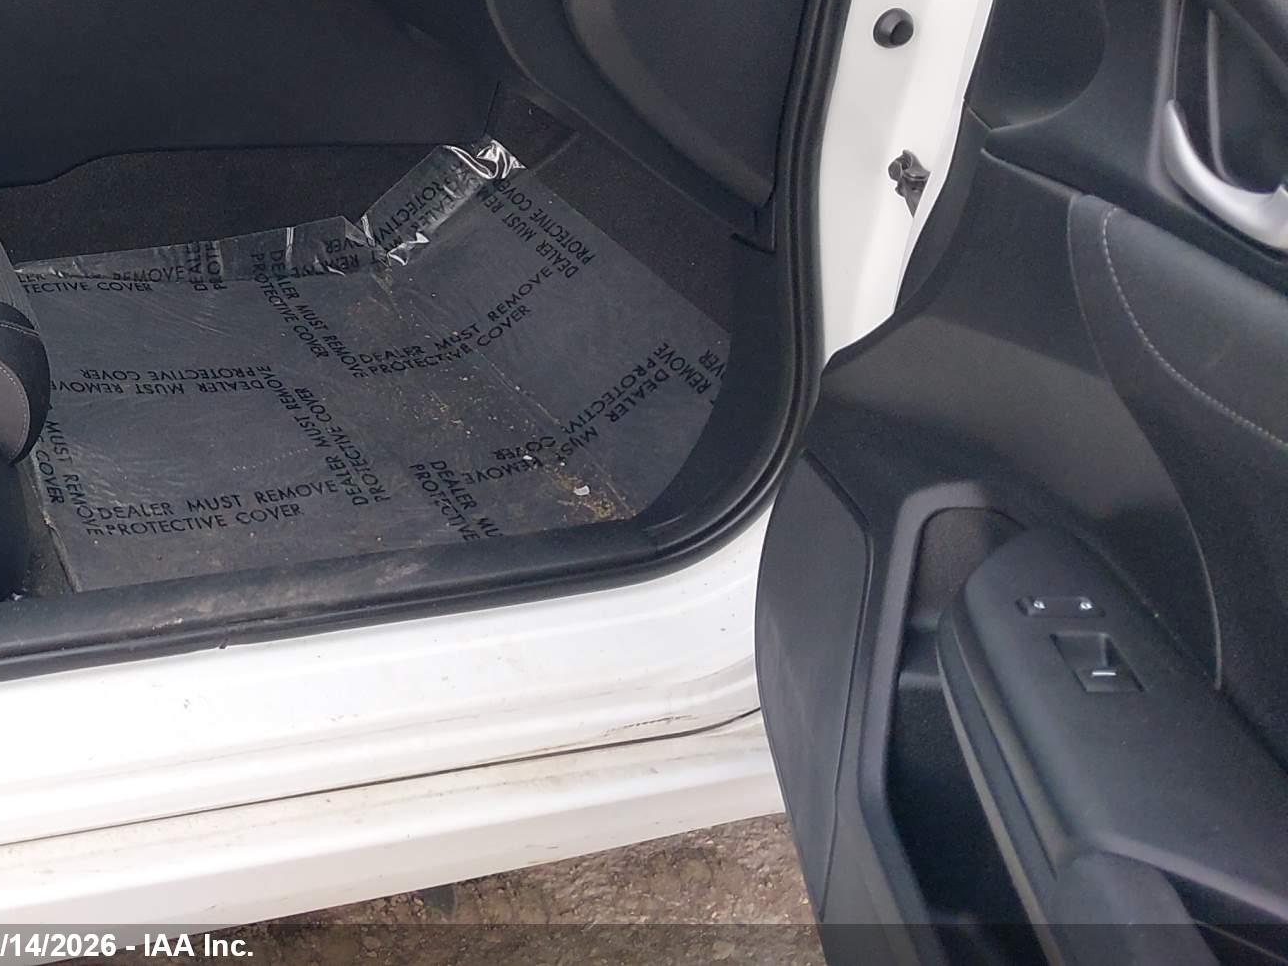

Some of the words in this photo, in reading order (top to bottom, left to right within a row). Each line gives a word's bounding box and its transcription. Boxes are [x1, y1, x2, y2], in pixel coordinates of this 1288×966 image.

[502, 212, 537, 242] MUST
[529, 208, 596, 266] PROTECTIVE
[536, 239, 580, 279] DEALER
[96, 281, 154, 293] COVER
[250, 252, 300, 323] PROTECTIVE
[293, 325, 329, 359] COVER
[359, 344, 425, 365] DEALER
[434, 322, 482, 351] MUST
[487, 265, 553, 323] REMOVE
[295, 304, 329, 331] MUST
[322, 335, 369, 378] REMOVE
[368, 344, 473, 377] PROTECTIVE
[476, 305, 532, 347] COVER
[79, 369, 141, 381] COVER
[135, 383, 185, 395] MUST
[149, 365, 256, 382] PROTECTIVE
[199, 380, 264, 393] DEALER
[253, 366, 302, 410] REMOVE
[653, 342, 712, 395] REMOVE
[294, 387, 333, 423] COVER
[604, 367, 670, 423] DEALER
[293, 415, 332, 448] MUST
[35, 449, 65, 505] COVER
[45, 420, 73, 464] MUST
[62, 474, 105, 536] REMOVE
[325, 425, 391, 503] PROTECTIVE
[326, 454, 369, 507] DEALER
[429, 459, 478, 510] DEALER
[97, 502, 174, 521] DEALER
[186, 494, 242, 513] MUST
[255, 480, 340, 506] REMOVE
[105, 514, 228, 536] PROTECTIVE
[235, 503, 303, 526] COVER
